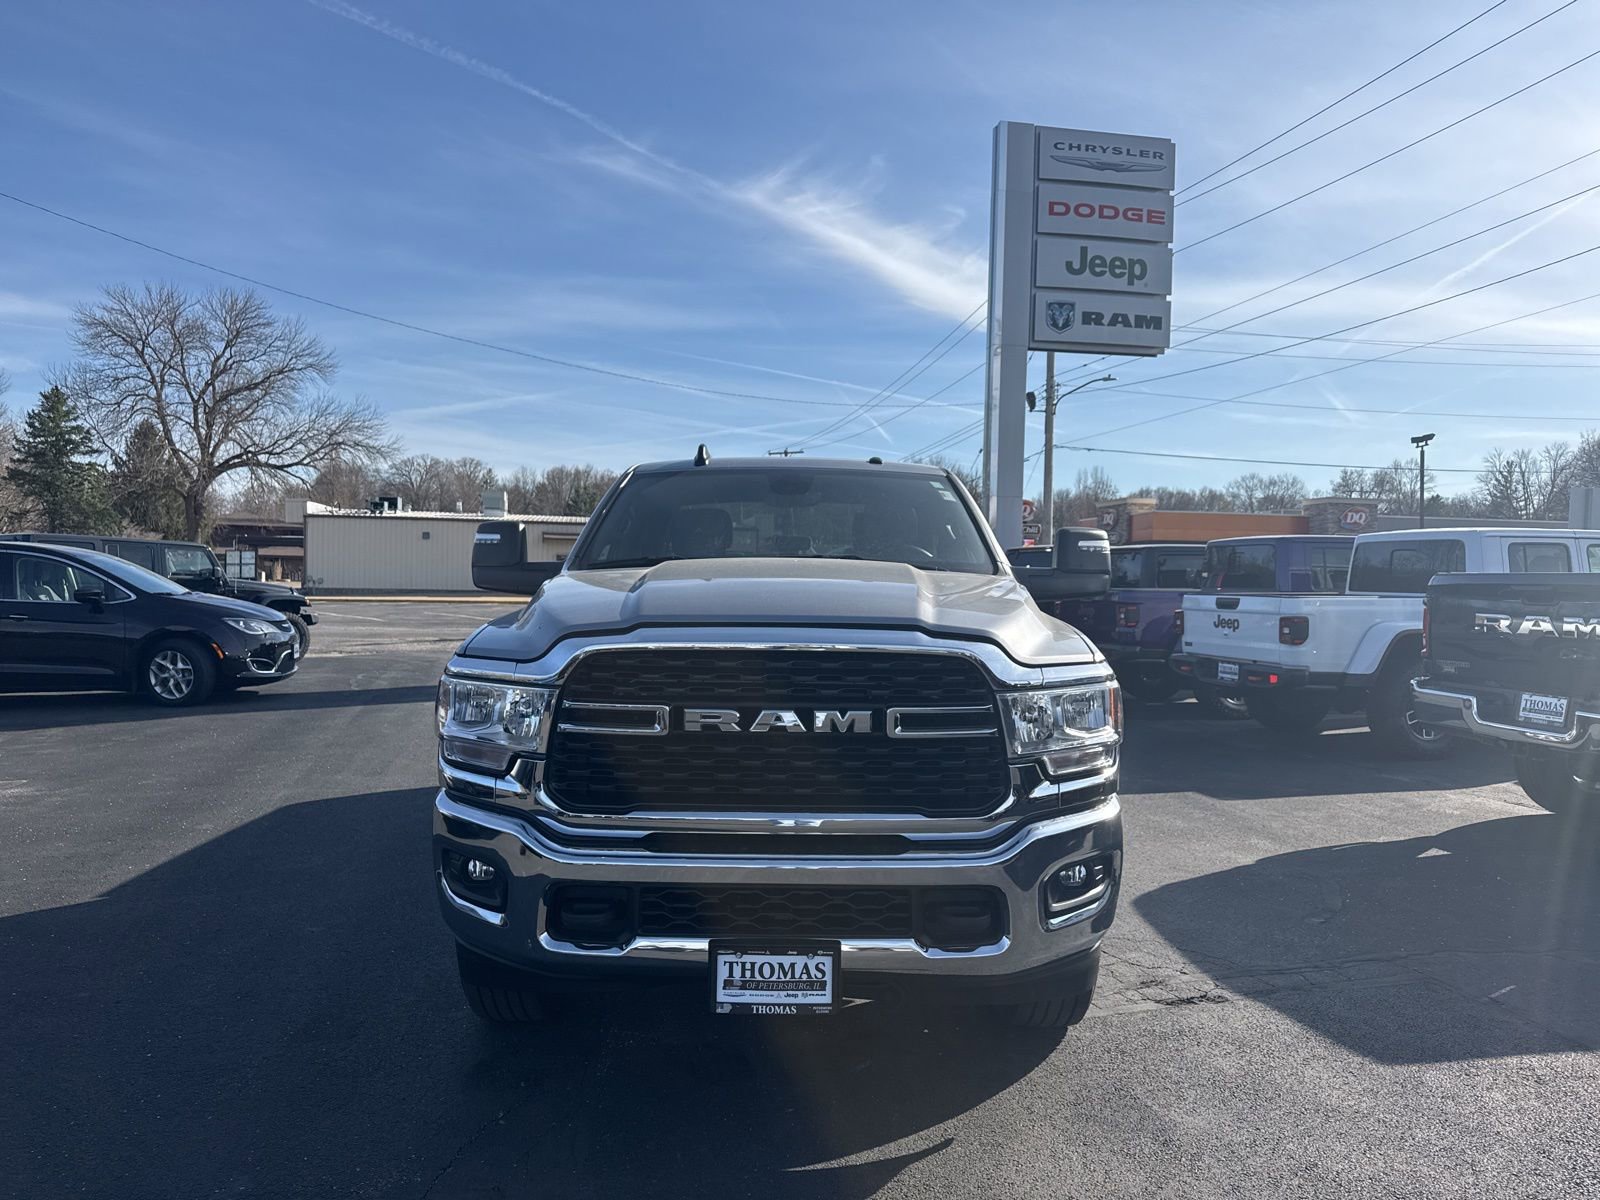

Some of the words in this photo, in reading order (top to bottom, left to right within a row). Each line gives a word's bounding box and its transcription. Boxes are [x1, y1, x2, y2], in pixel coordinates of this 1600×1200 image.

[1053, 141, 1165, 161] CHRYSLER
[1048, 201, 1166, 225] DODGE
[1065, 246, 1148, 286] Jeep
[1081, 311, 1163, 331] RAM
[1103, 513, 1114, 525] DQ
[1347, 511, 1367, 525] DQ
[1213, 614, 1240, 632] Jeep
[1473, 613, 1600, 640] RAM
[1523, 698, 1565, 711] THOMAS
[684, 708, 873, 732] RAM
[723, 960, 827, 980] THOMAS
[746, 981, 757, 989] OF
[813, 982, 821, 990] IL
[751, 1005, 797, 1014] THOMAS
